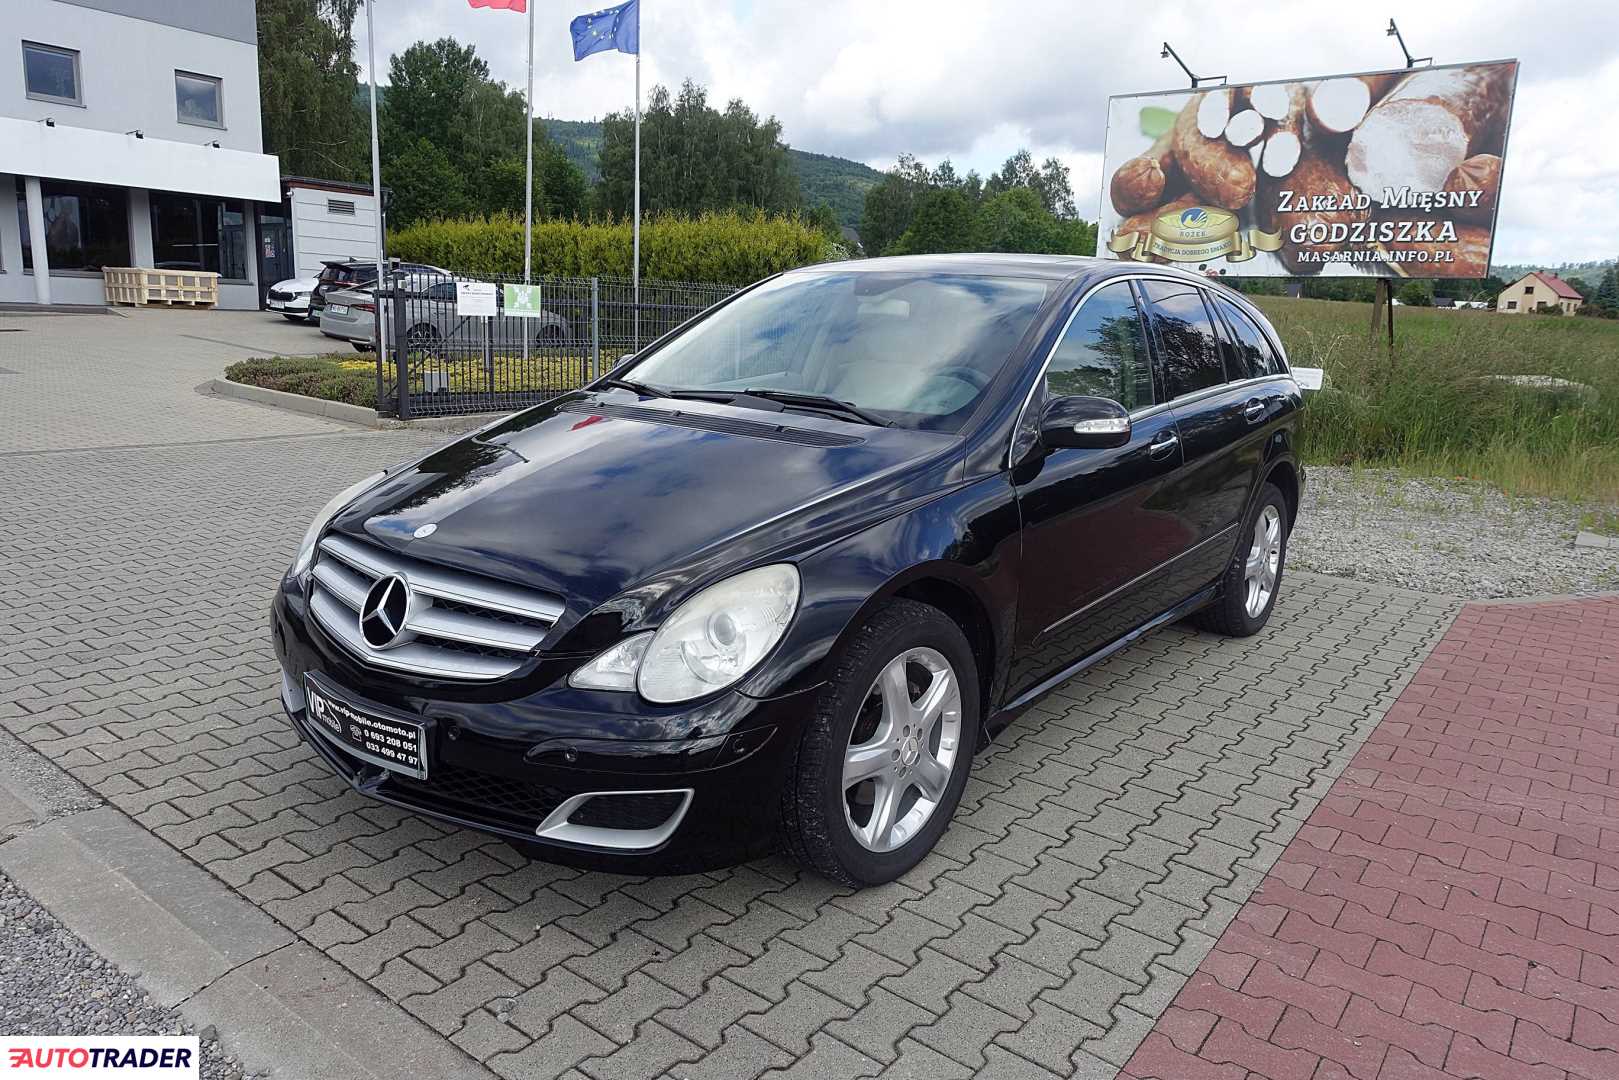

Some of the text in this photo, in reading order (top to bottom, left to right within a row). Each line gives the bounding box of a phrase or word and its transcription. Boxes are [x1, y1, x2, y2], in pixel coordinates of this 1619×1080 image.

[1290, 221, 1458, 244] GODZISZKA
[306, 686, 325, 719] VIP
[364, 729, 417, 752] 0 693 208 051
[366, 742, 418, 765] 033 499 47 97
